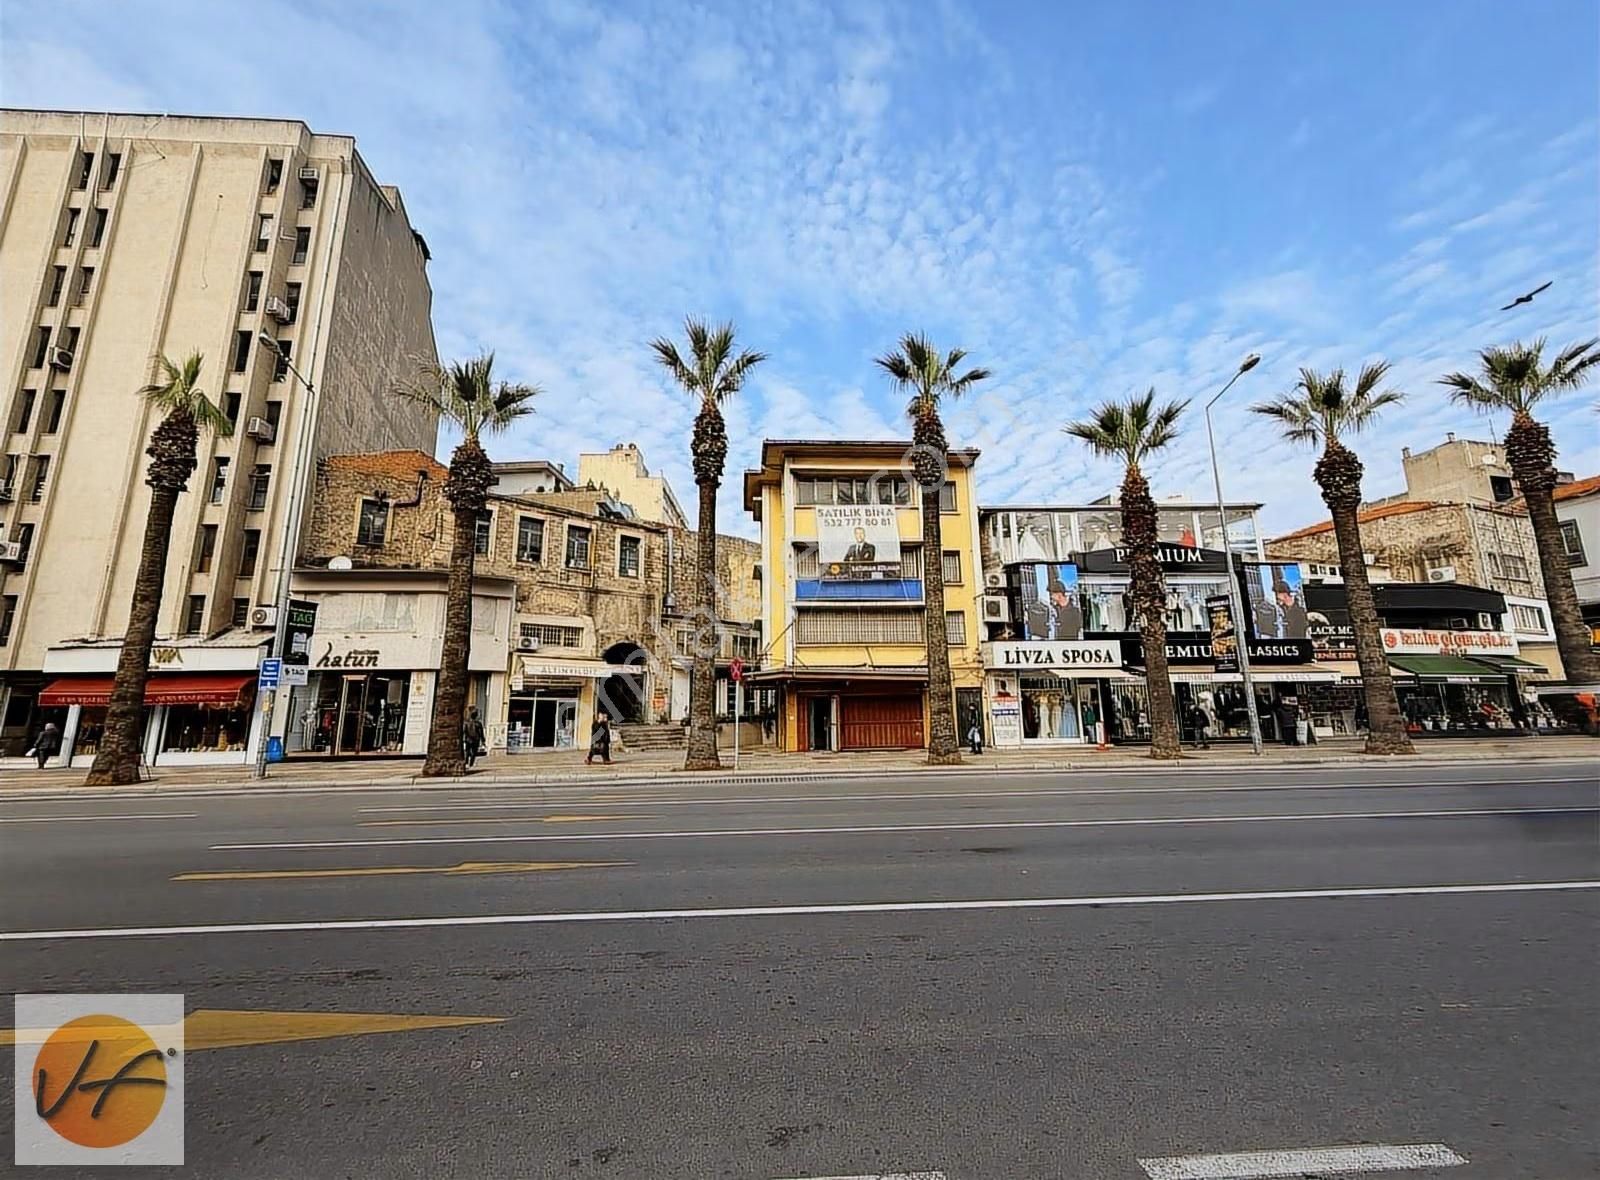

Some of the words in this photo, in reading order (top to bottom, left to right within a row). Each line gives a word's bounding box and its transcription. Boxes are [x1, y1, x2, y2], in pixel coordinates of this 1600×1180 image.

[818, 508, 861, 518] SATILIK
[865, 507, 894, 517] BİNA
[825, 519, 842, 527] 532
[1112, 548, 1203, 563] PMIUM
[1310, 626, 1336, 634] LACK
[316, 642, 379, 667] hatun
[1005, 647, 1055, 664] LİVZA
[1062, 649, 1114, 663] SPOSA
[1140, 645, 1212, 658] EMIU
[1248, 645, 1300, 657] LASSICS
